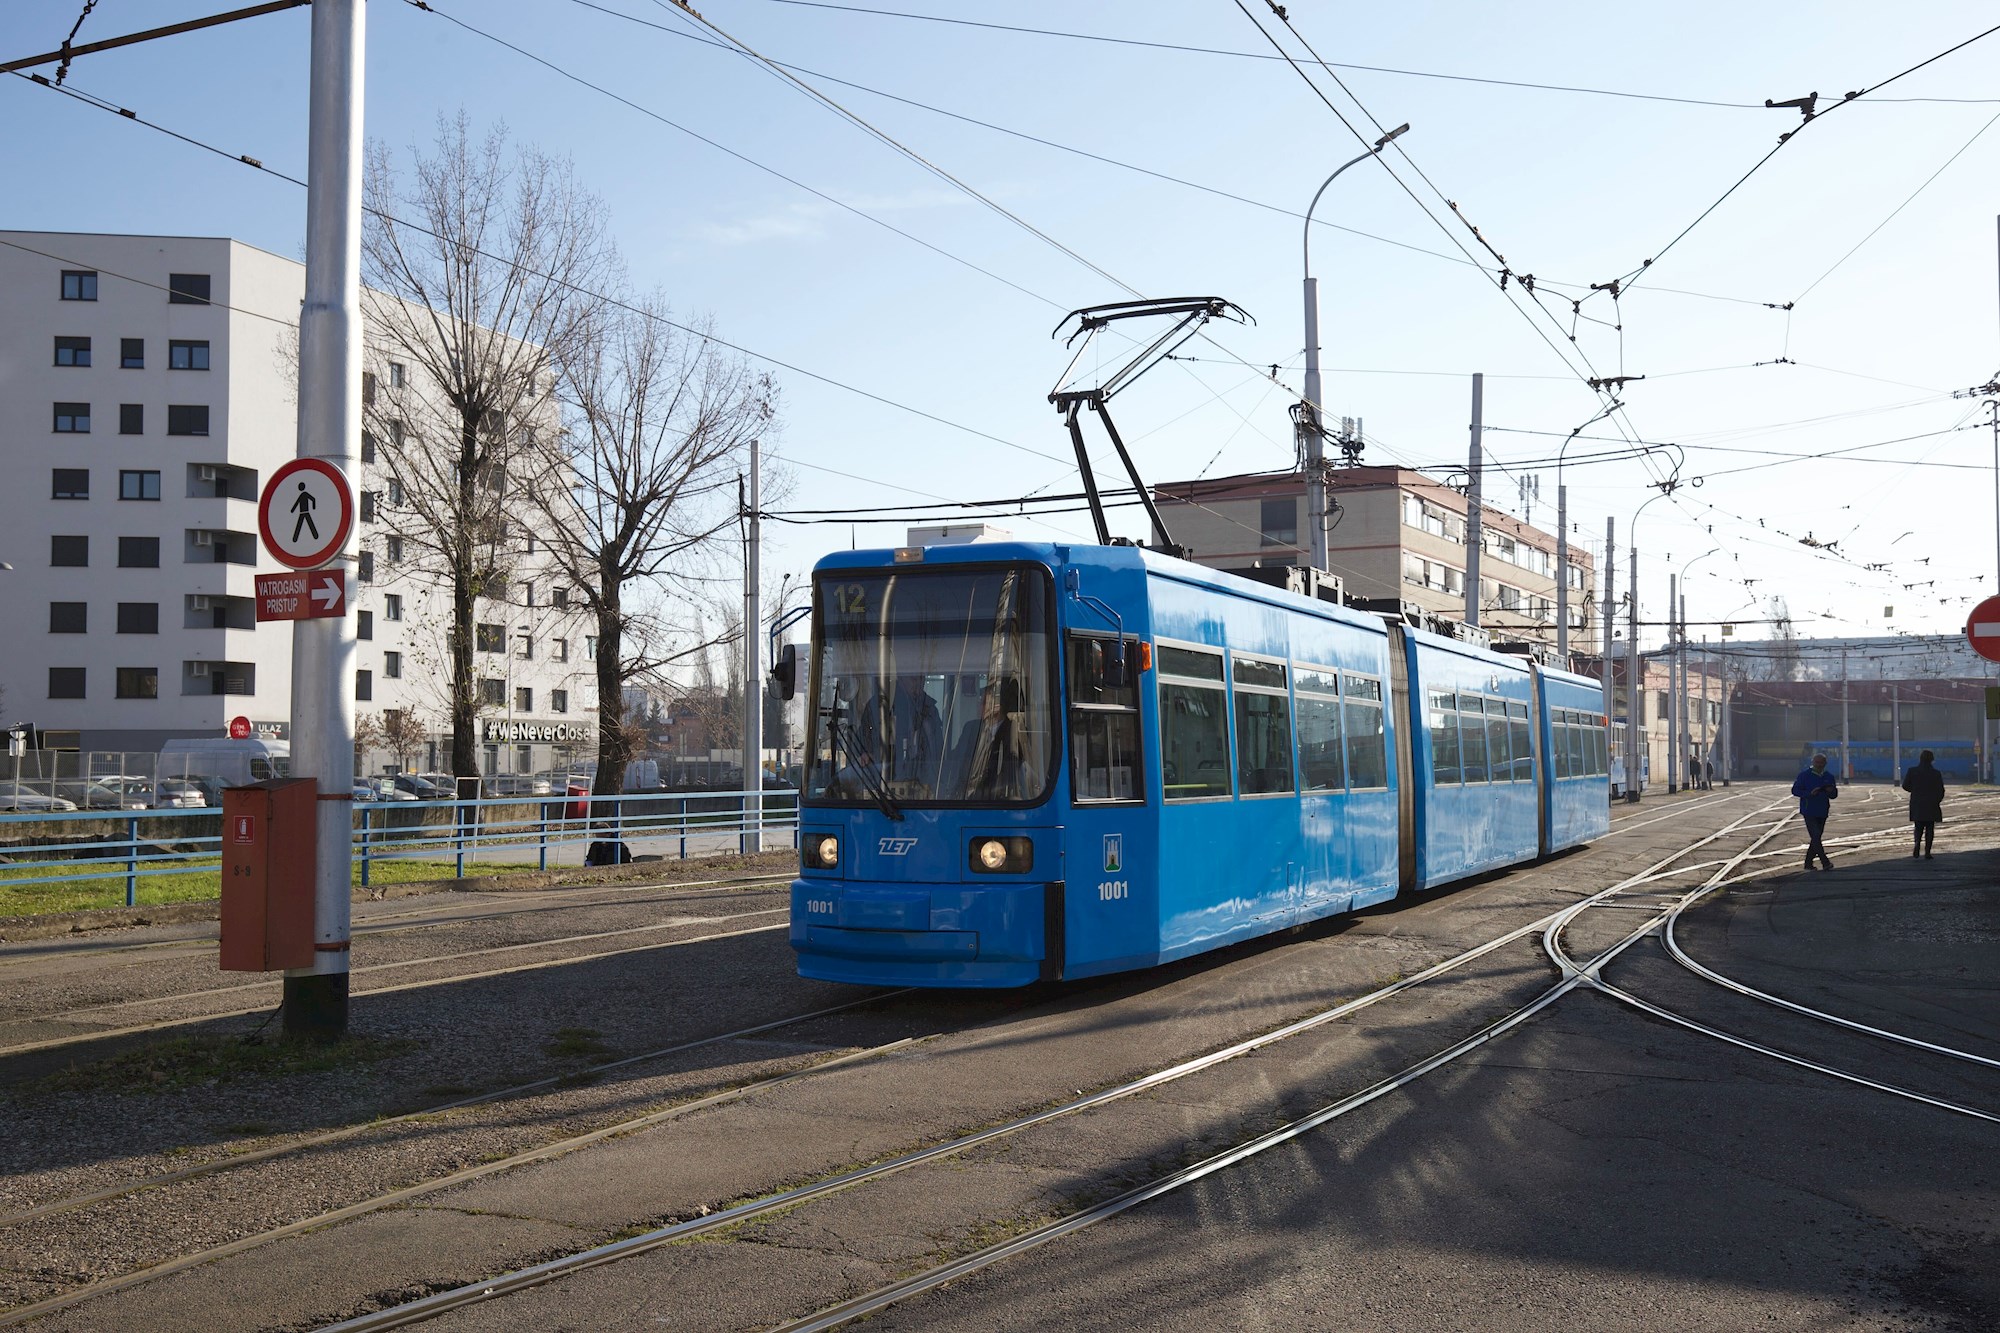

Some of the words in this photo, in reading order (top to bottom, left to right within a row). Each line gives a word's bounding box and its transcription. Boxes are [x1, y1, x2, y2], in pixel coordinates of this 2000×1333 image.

[258, 579, 307, 597] VATROGASNI
[266, 597, 298, 614] PRISTUP
[833, 584, 866, 613] 12
[258, 724, 282, 733] ULAZ
[488, 721, 591, 741] #WeNeverClose
[879, 838, 919, 855] ZET
[1098, 880, 1128, 901] 1001
[807, 900, 833, 914] 1001
